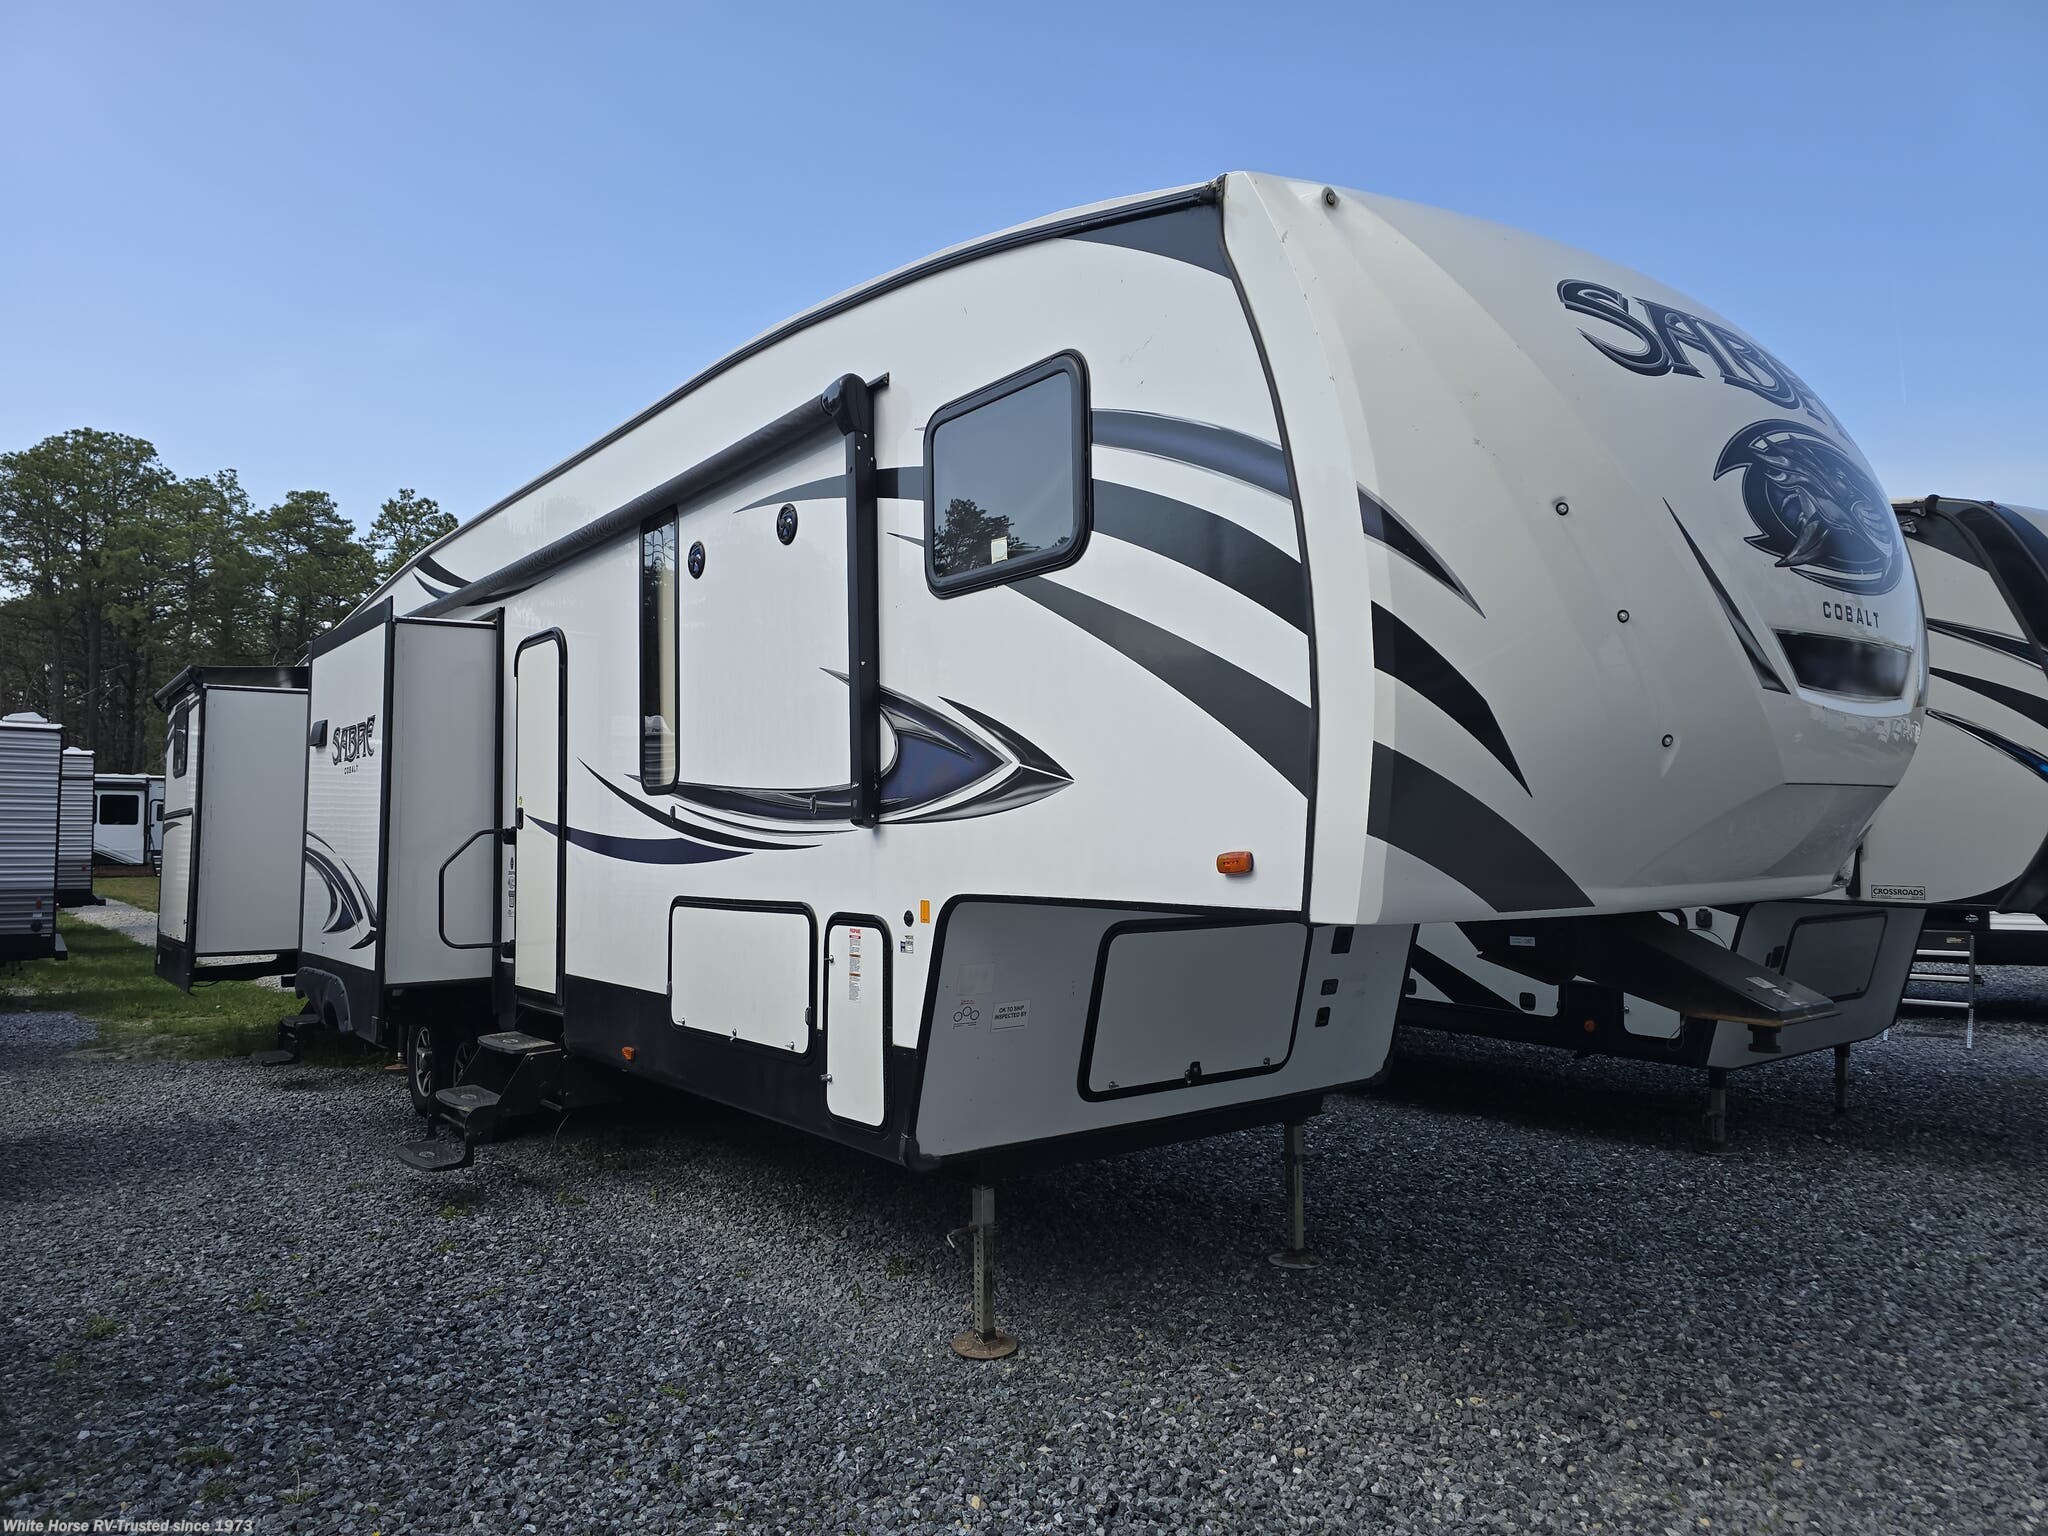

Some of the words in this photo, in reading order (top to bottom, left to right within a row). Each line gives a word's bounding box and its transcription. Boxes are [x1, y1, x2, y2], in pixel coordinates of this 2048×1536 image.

[1822, 601, 1880, 629] COBALT
[332, 714, 376, 766] SABRE
[1872, 888, 1924, 896] CROSSROADS
[995, 1012, 1020, 1020] INSPECTED
